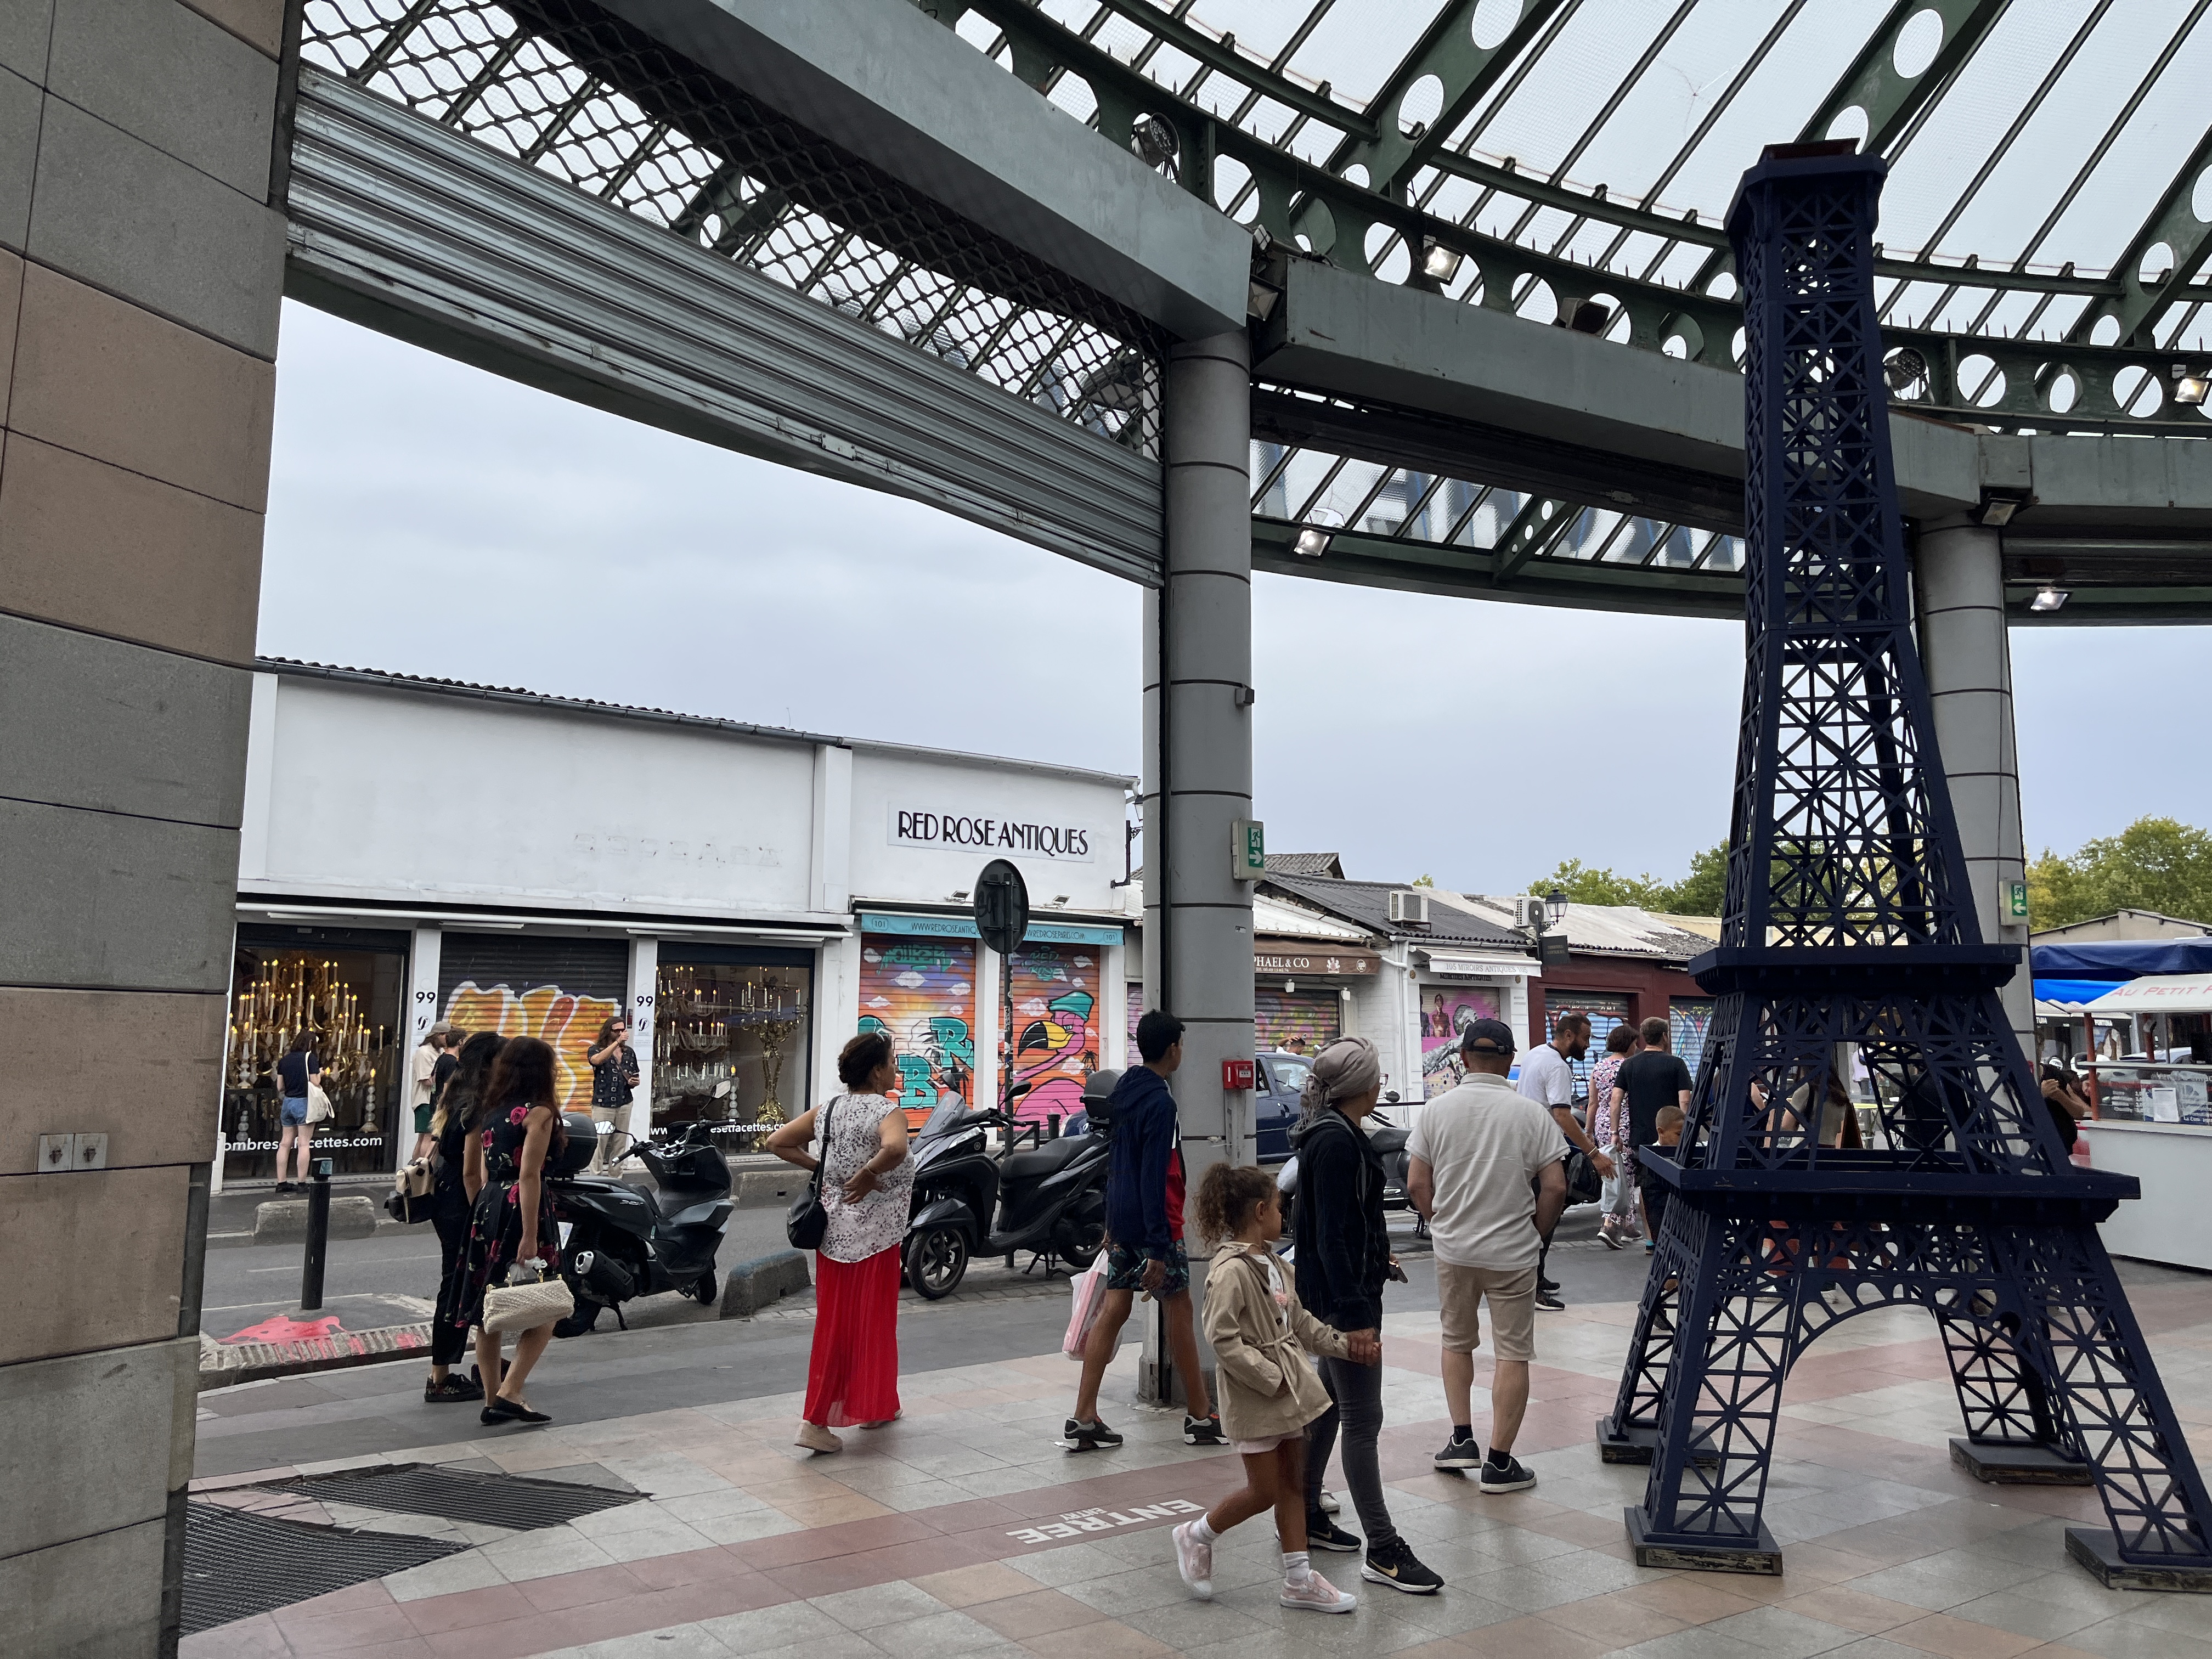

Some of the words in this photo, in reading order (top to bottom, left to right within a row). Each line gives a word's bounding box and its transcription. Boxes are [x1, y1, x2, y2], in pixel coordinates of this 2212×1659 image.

[898, 811, 939, 840] RED
[943, 815, 995, 846] ROSE
[998, 821, 1088, 856] ANTIQUES
[874, 920, 886, 928] 101
[1285, 958, 1291, 968] &
[1293, 957, 1310, 968] CO
[1458, 963, 1483, 972] MIROIRS
[416, 991, 436, 1003] 99
[2110, 988, 2138, 996] AU
[2143, 987, 2197, 996] PETIT
[637, 996, 653, 1007] 99
[1059, 1507, 1108, 1522] ENTRY
[1005, 1499, 1206, 1544] ENTREE
